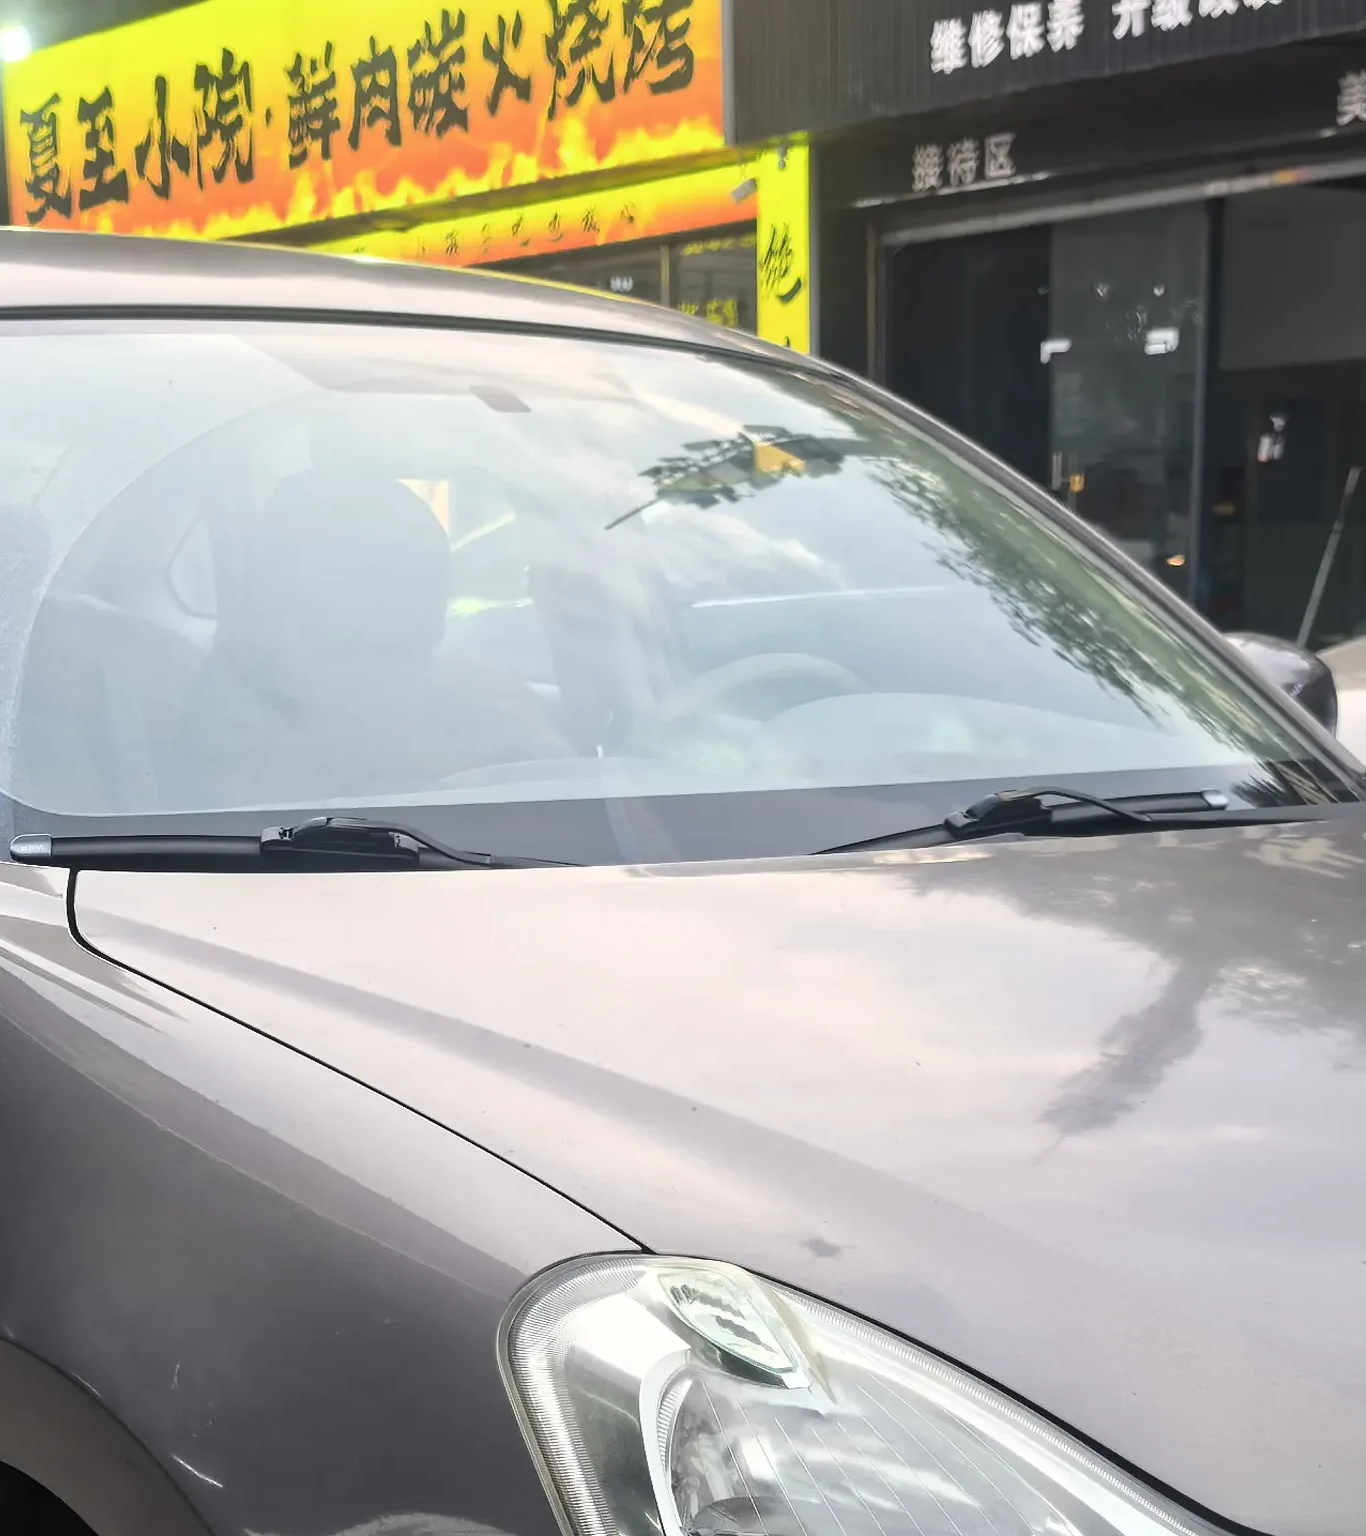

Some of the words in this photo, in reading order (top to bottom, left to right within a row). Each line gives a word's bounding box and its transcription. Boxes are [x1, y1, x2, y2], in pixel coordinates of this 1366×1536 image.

[929, 0, 1085, 74] 维修保养
[1111, 0, 1283, 39] 升级
